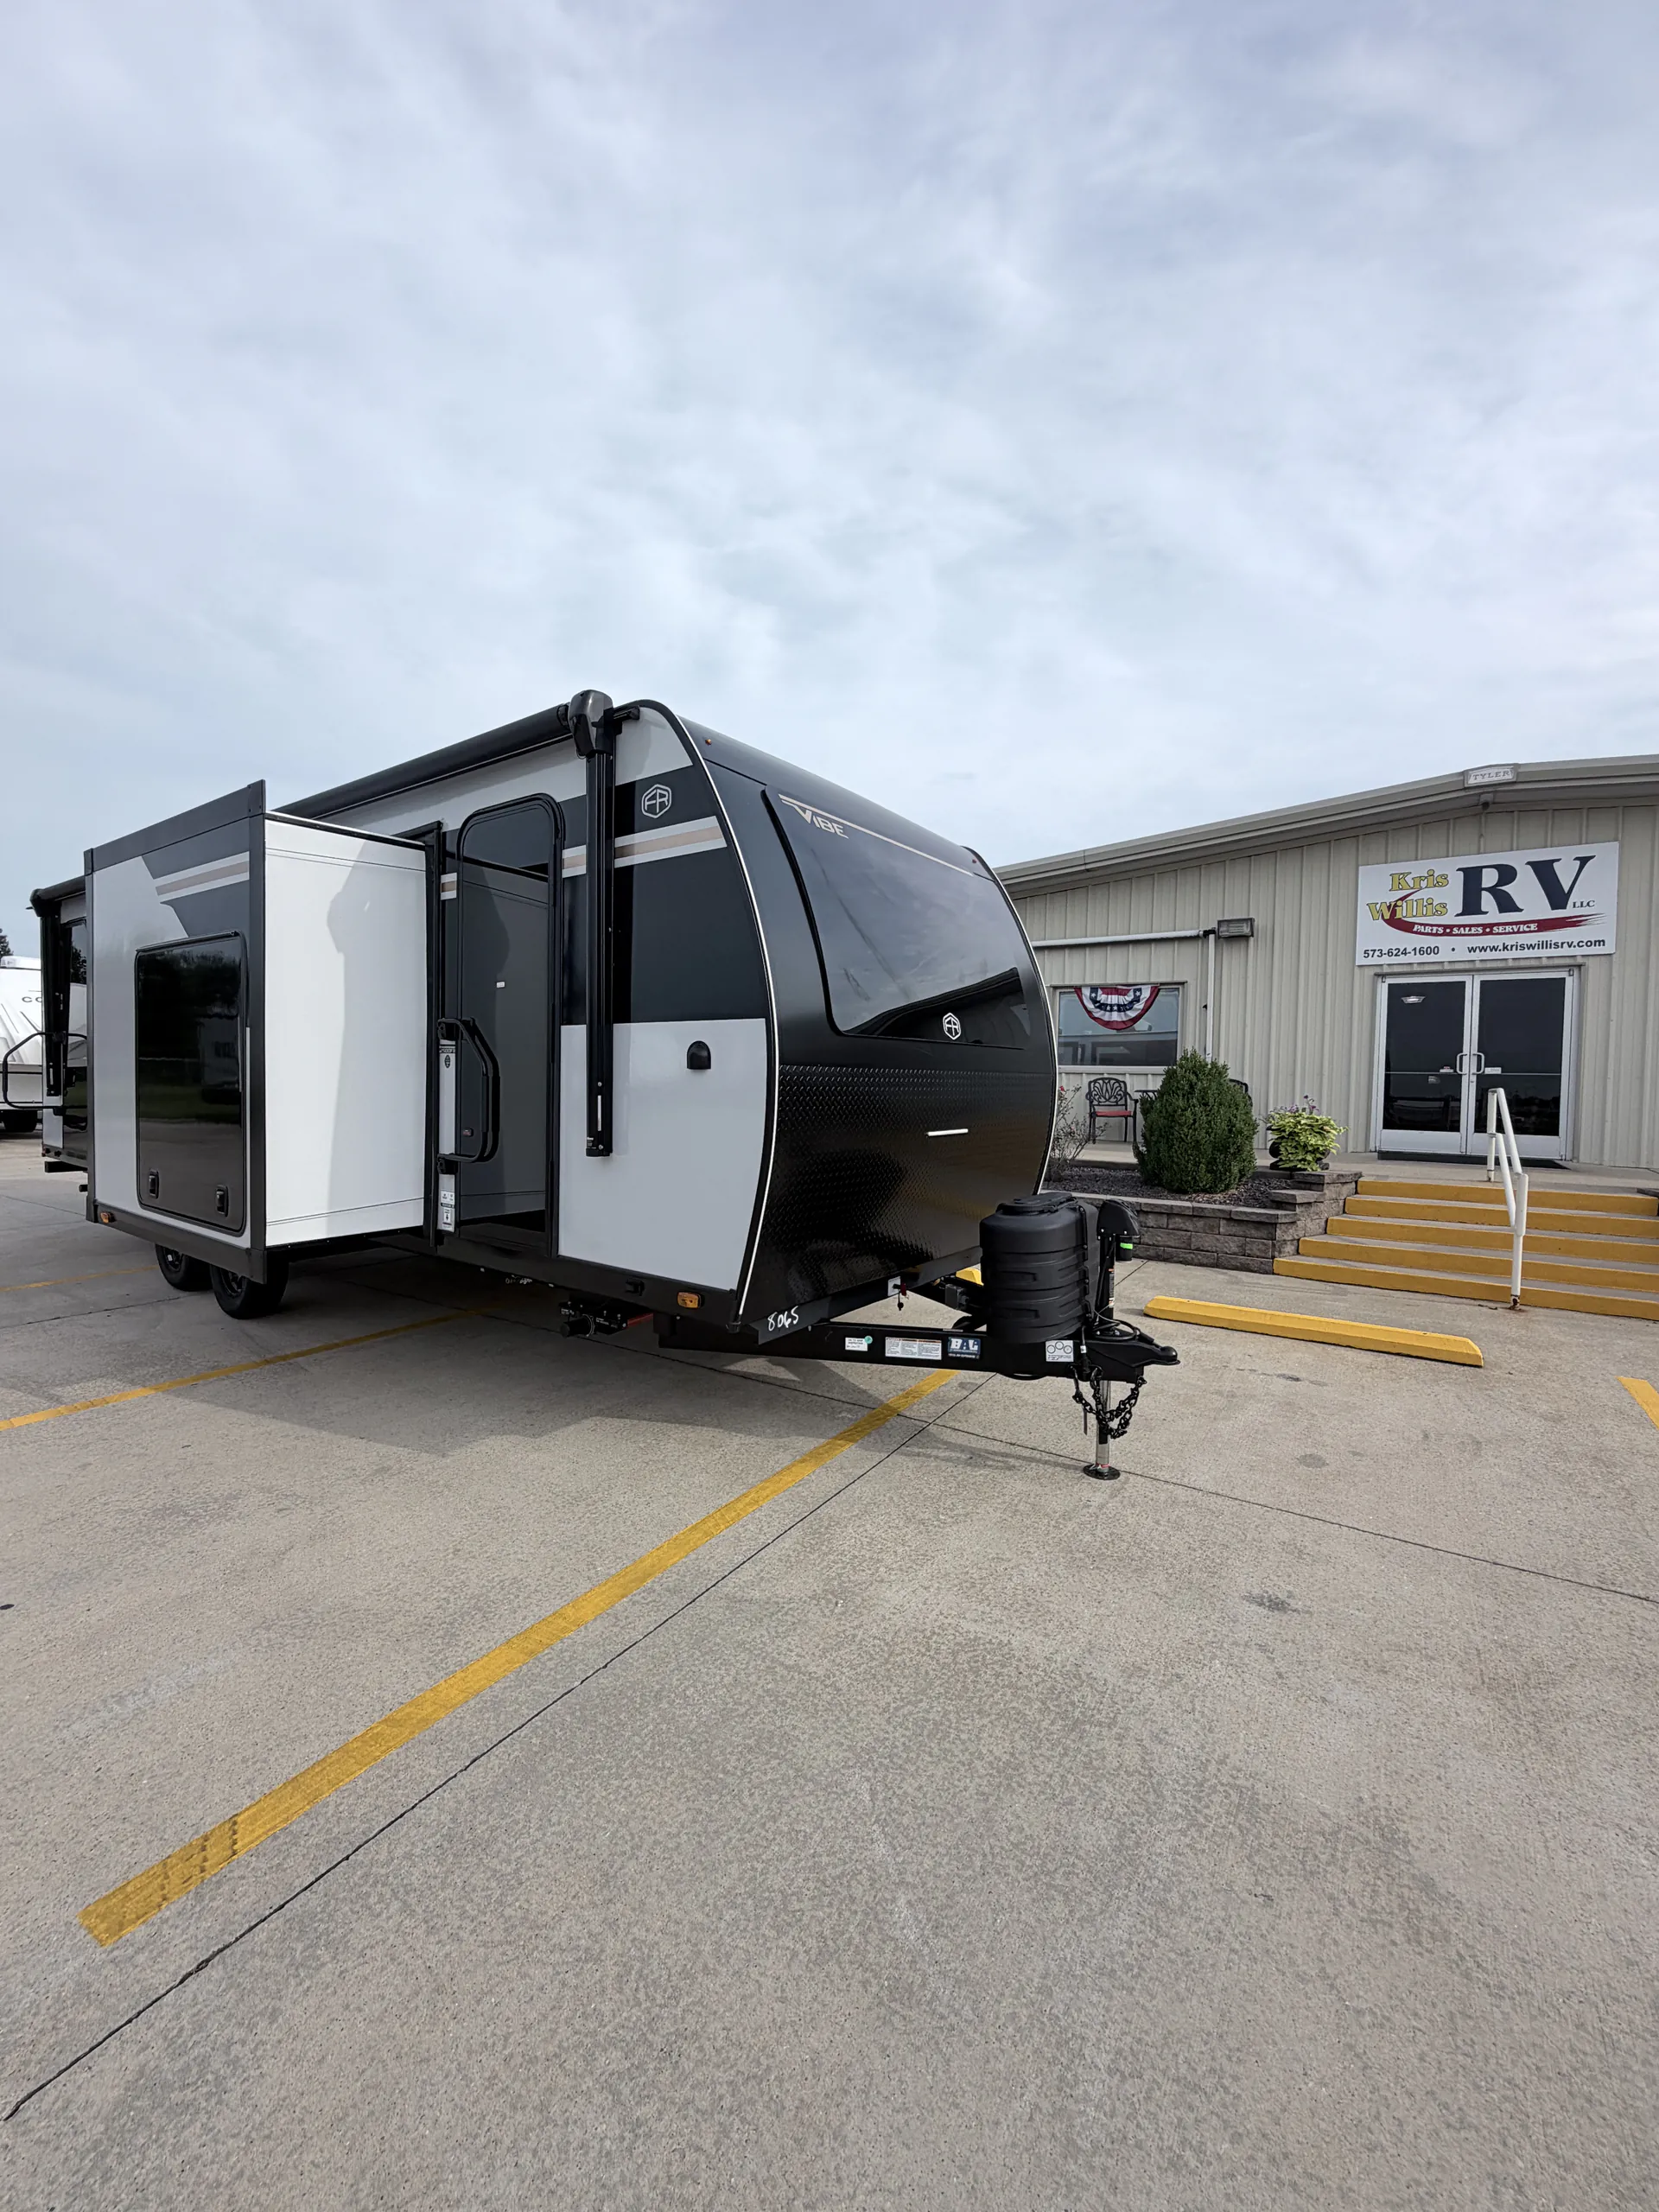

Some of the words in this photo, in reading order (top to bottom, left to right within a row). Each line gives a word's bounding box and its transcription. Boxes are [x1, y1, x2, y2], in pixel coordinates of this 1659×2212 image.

[1472, 770, 1510, 780] TYLER
[781, 799, 849, 839] VIBE
[1389, 868, 1449, 892] Kris
[1454, 855, 1597, 918] RV
[1366, 897, 1448, 921] Willis
[1572, 899, 1596, 909] LLC
[1412, 925, 1444, 934] PARTS
[1452, 926, 1484, 935] SALES
[1492, 923, 1539, 934] SERVICE
[1363, 945, 1440, 958] 573-624-1600
[1466, 938, 1606, 954] www.kriswillisrv.com
